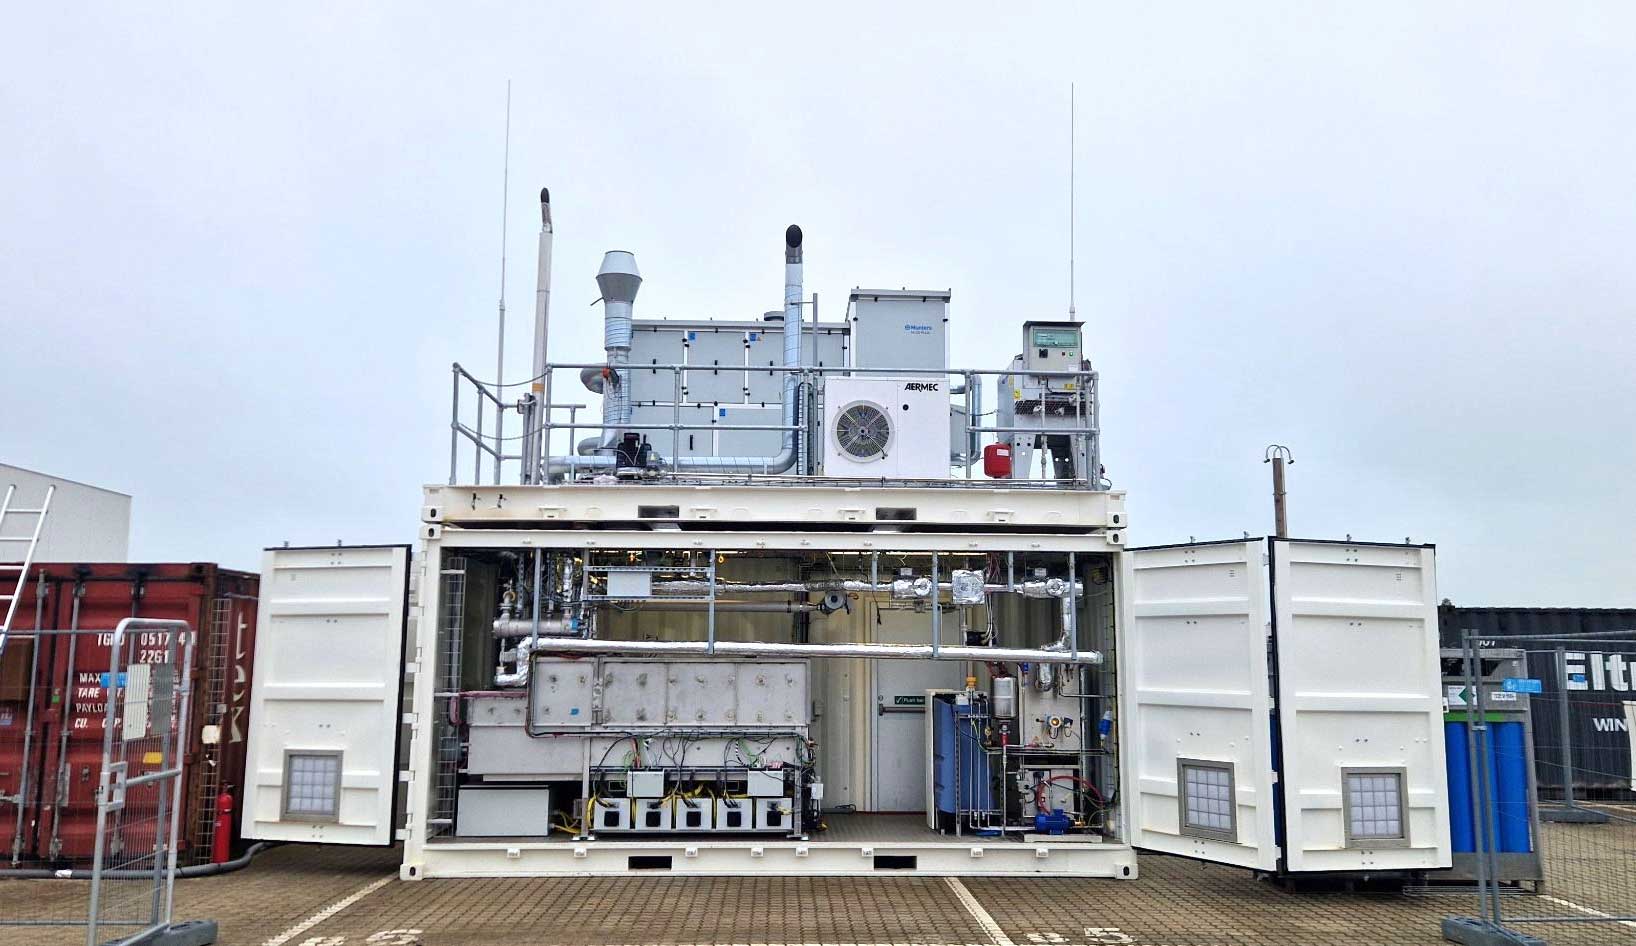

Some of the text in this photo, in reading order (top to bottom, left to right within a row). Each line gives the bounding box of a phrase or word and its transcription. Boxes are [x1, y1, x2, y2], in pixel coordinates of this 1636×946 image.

[904, 382, 939, 393] AERMEC
[139, 650, 169, 664] 22G1
[78, 687, 100, 698] TARE
[101, 718, 123, 728] CP.
